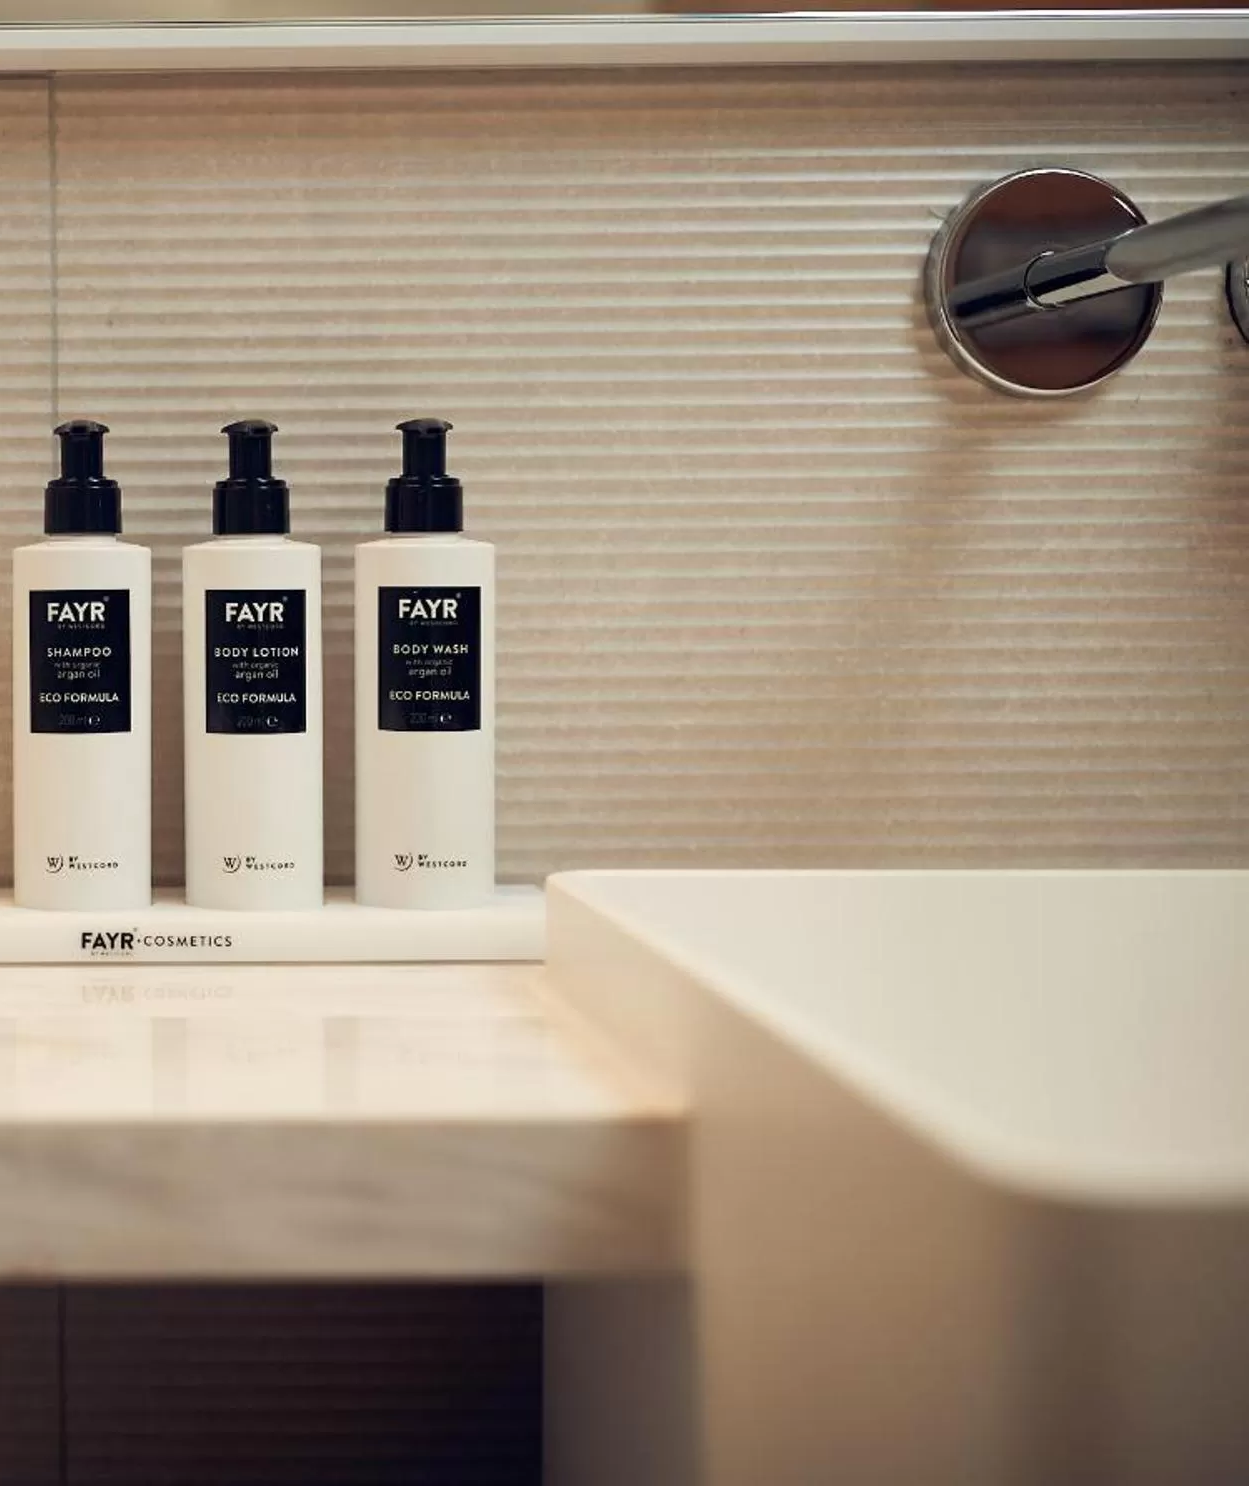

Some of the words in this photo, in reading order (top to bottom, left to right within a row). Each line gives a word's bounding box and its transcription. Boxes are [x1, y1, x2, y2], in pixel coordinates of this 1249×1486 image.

[46, 602, 106, 622] FAYR
[225, 602, 284, 622] FAYR
[398, 598, 458, 619] FAYR
[47, 647, 112, 658] SHAMPOO
[214, 647, 248, 658] BODY
[253, 647, 299, 658] LOTION
[393, 644, 429, 654] BODY
[432, 644, 469, 654] WASH
[57, 670, 86, 681] argan
[87, 669, 100, 679] oil
[235, 670, 264, 682] argan
[266, 669, 279, 679] oil
[39, 692, 62, 703] ECO
[64, 692, 120, 703] FORMULA
[217, 692, 240, 703] ECO
[242, 692, 297, 703] FORMULA
[389, 690, 412, 700] ECO
[415, 690, 470, 700] FORMULA
[81, 932, 134, 950] FAYR
[144, 936, 232, 947] COSMETICS
